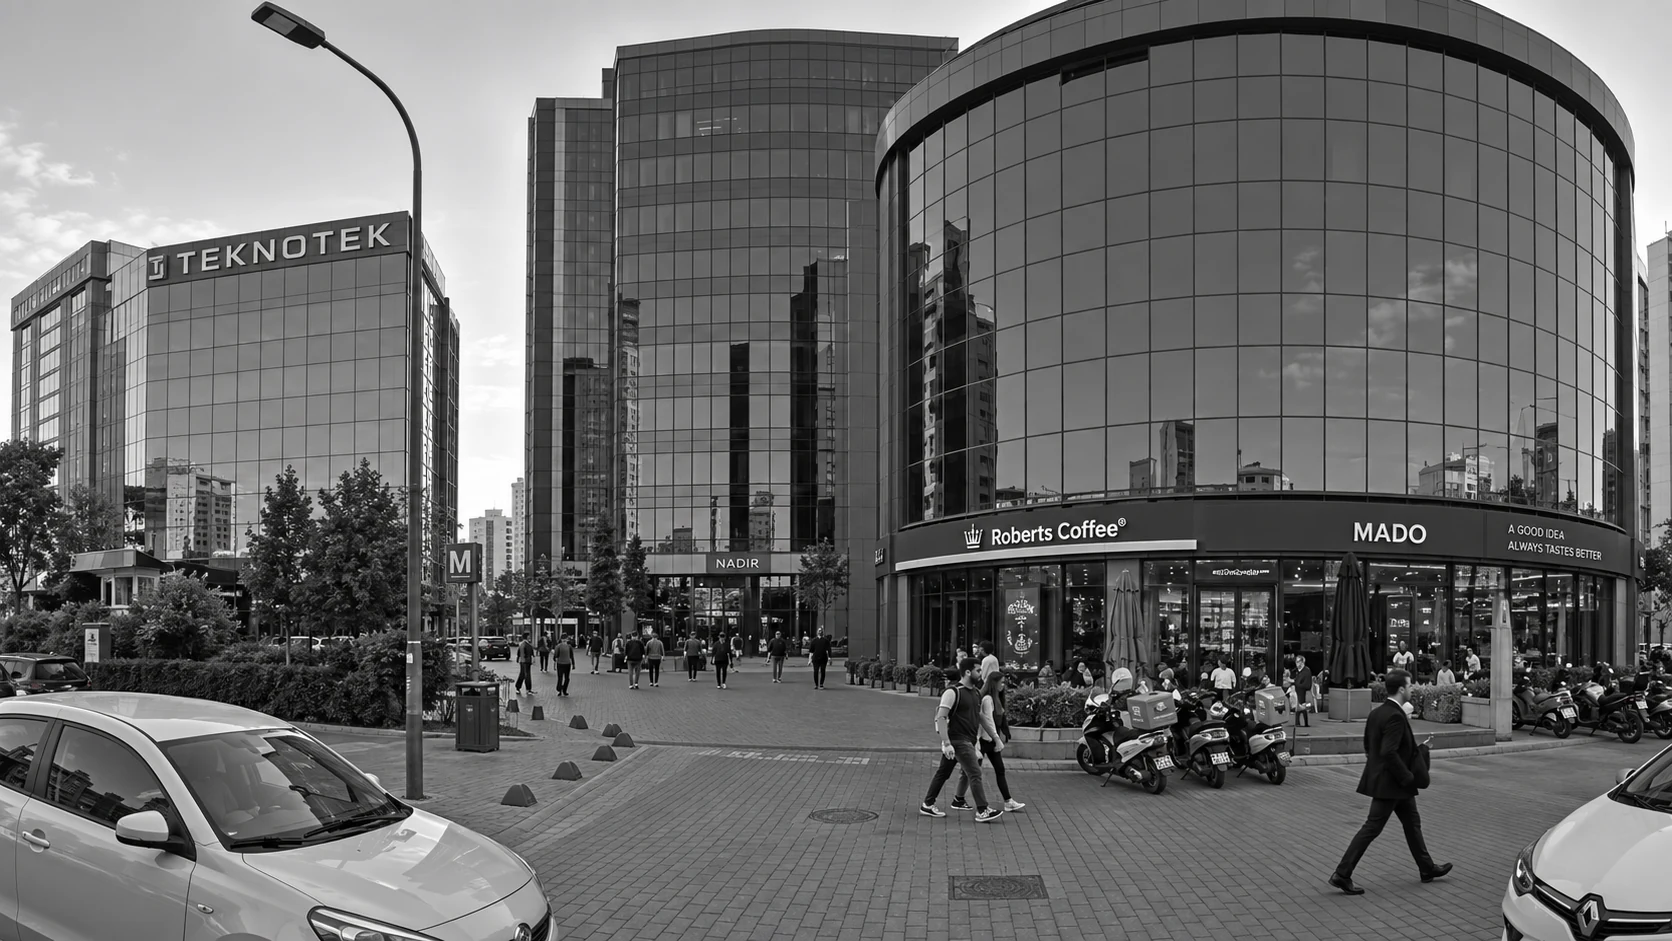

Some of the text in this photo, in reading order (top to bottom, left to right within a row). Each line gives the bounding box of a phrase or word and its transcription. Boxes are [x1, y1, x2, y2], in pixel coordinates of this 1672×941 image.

[177, 222, 391, 275] TEKNOTEK
[991, 525, 1053, 546] Roberts
[1353, 521, 1427, 544] MADO
[1507, 524, 1565, 541] A GOOD IDEA
[1507, 540, 1602, 561] ALWAYS TASTES BETTER
[449, 549, 471, 574] M
[715, 558, 760, 569] NADIR
